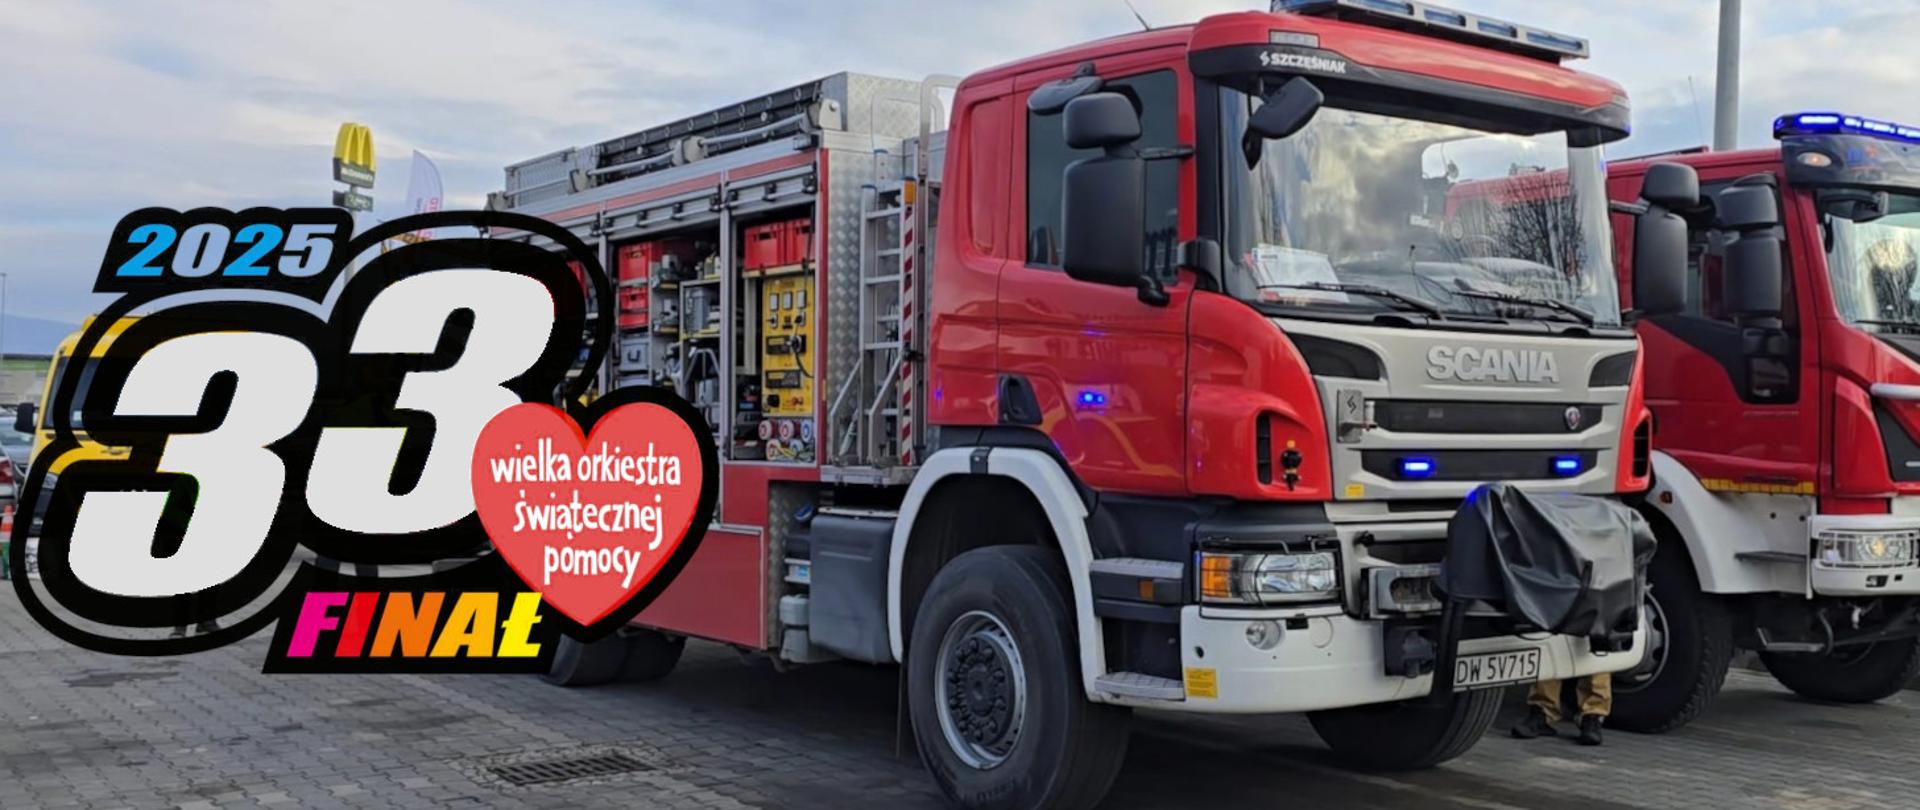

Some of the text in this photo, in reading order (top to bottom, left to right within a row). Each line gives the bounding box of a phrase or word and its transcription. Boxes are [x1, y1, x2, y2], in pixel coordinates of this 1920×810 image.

[1270, 53, 1346, 74] SZCZĘŚNIAK
[1426, 345, 1560, 383] SCANIA
[1456, 653, 1536, 684] DW 5V715
